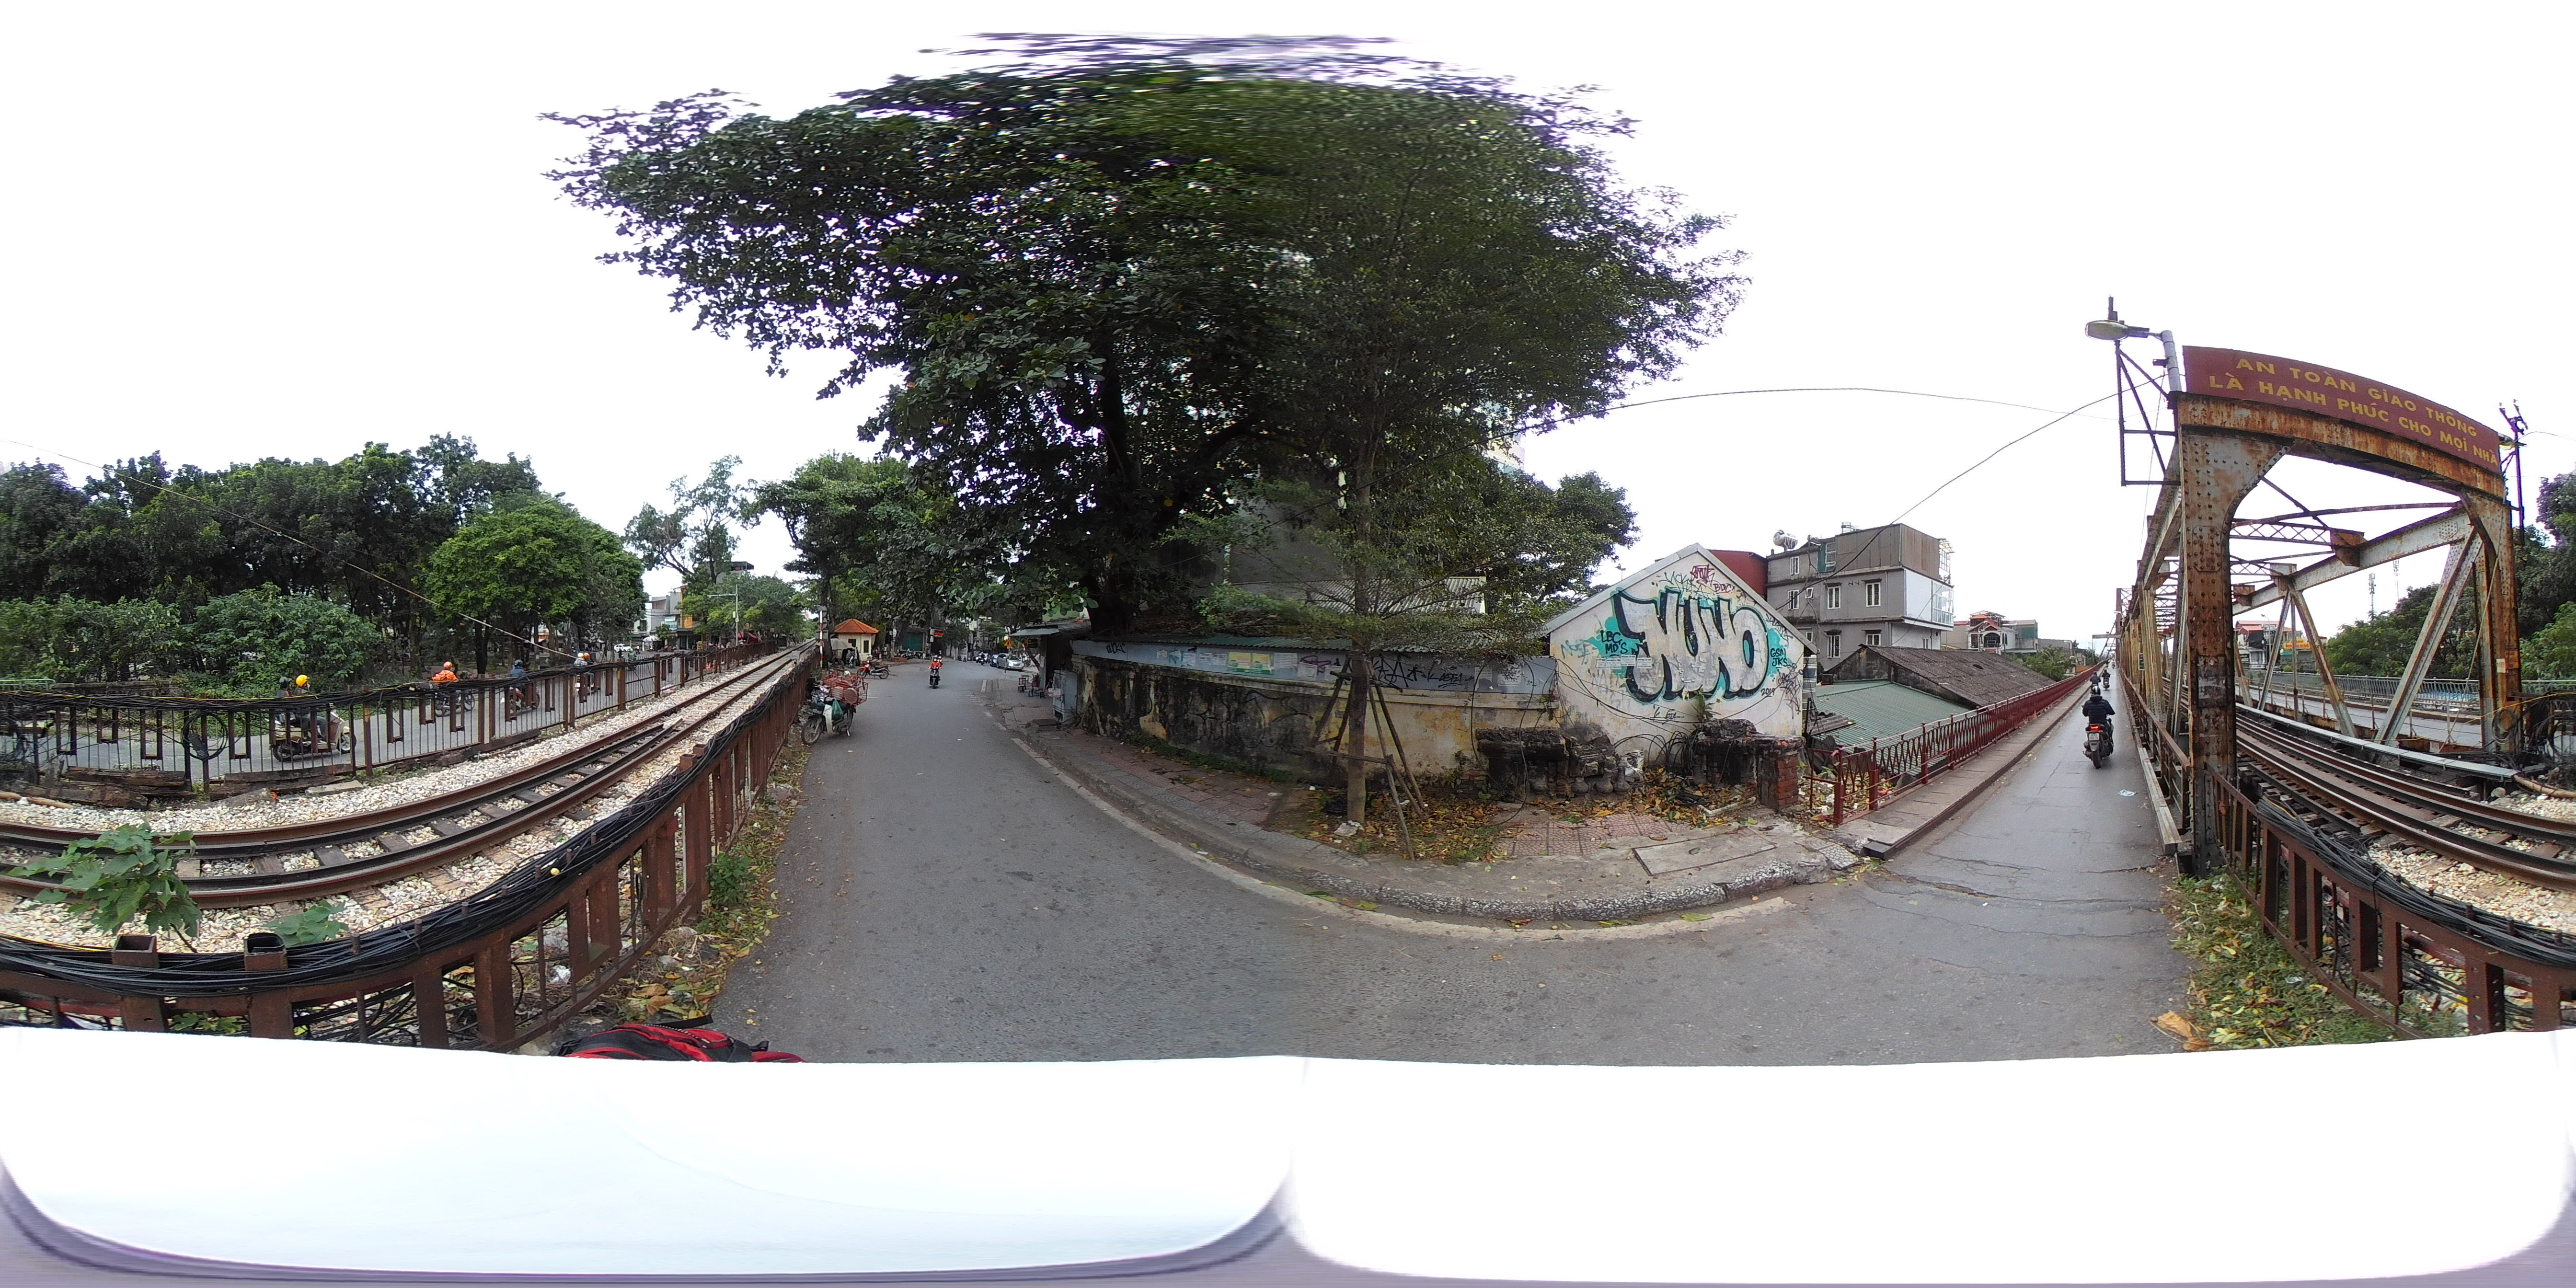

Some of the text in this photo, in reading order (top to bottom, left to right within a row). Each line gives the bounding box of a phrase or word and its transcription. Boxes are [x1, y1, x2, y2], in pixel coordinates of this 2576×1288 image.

[2209, 372, 2244, 391] LÀ
[2259, 381, 2326, 405] HẠNH
[2337, 398, 2389, 422] PHÚC
[2398, 416, 2431, 436] CHO
[2473, 445, 2498, 466] NHÀ
[2236, 359, 2275, 374] AN
[2289, 367, 2356, 393] TOÀN
[2426, 407, 2477, 437] THÔNG
